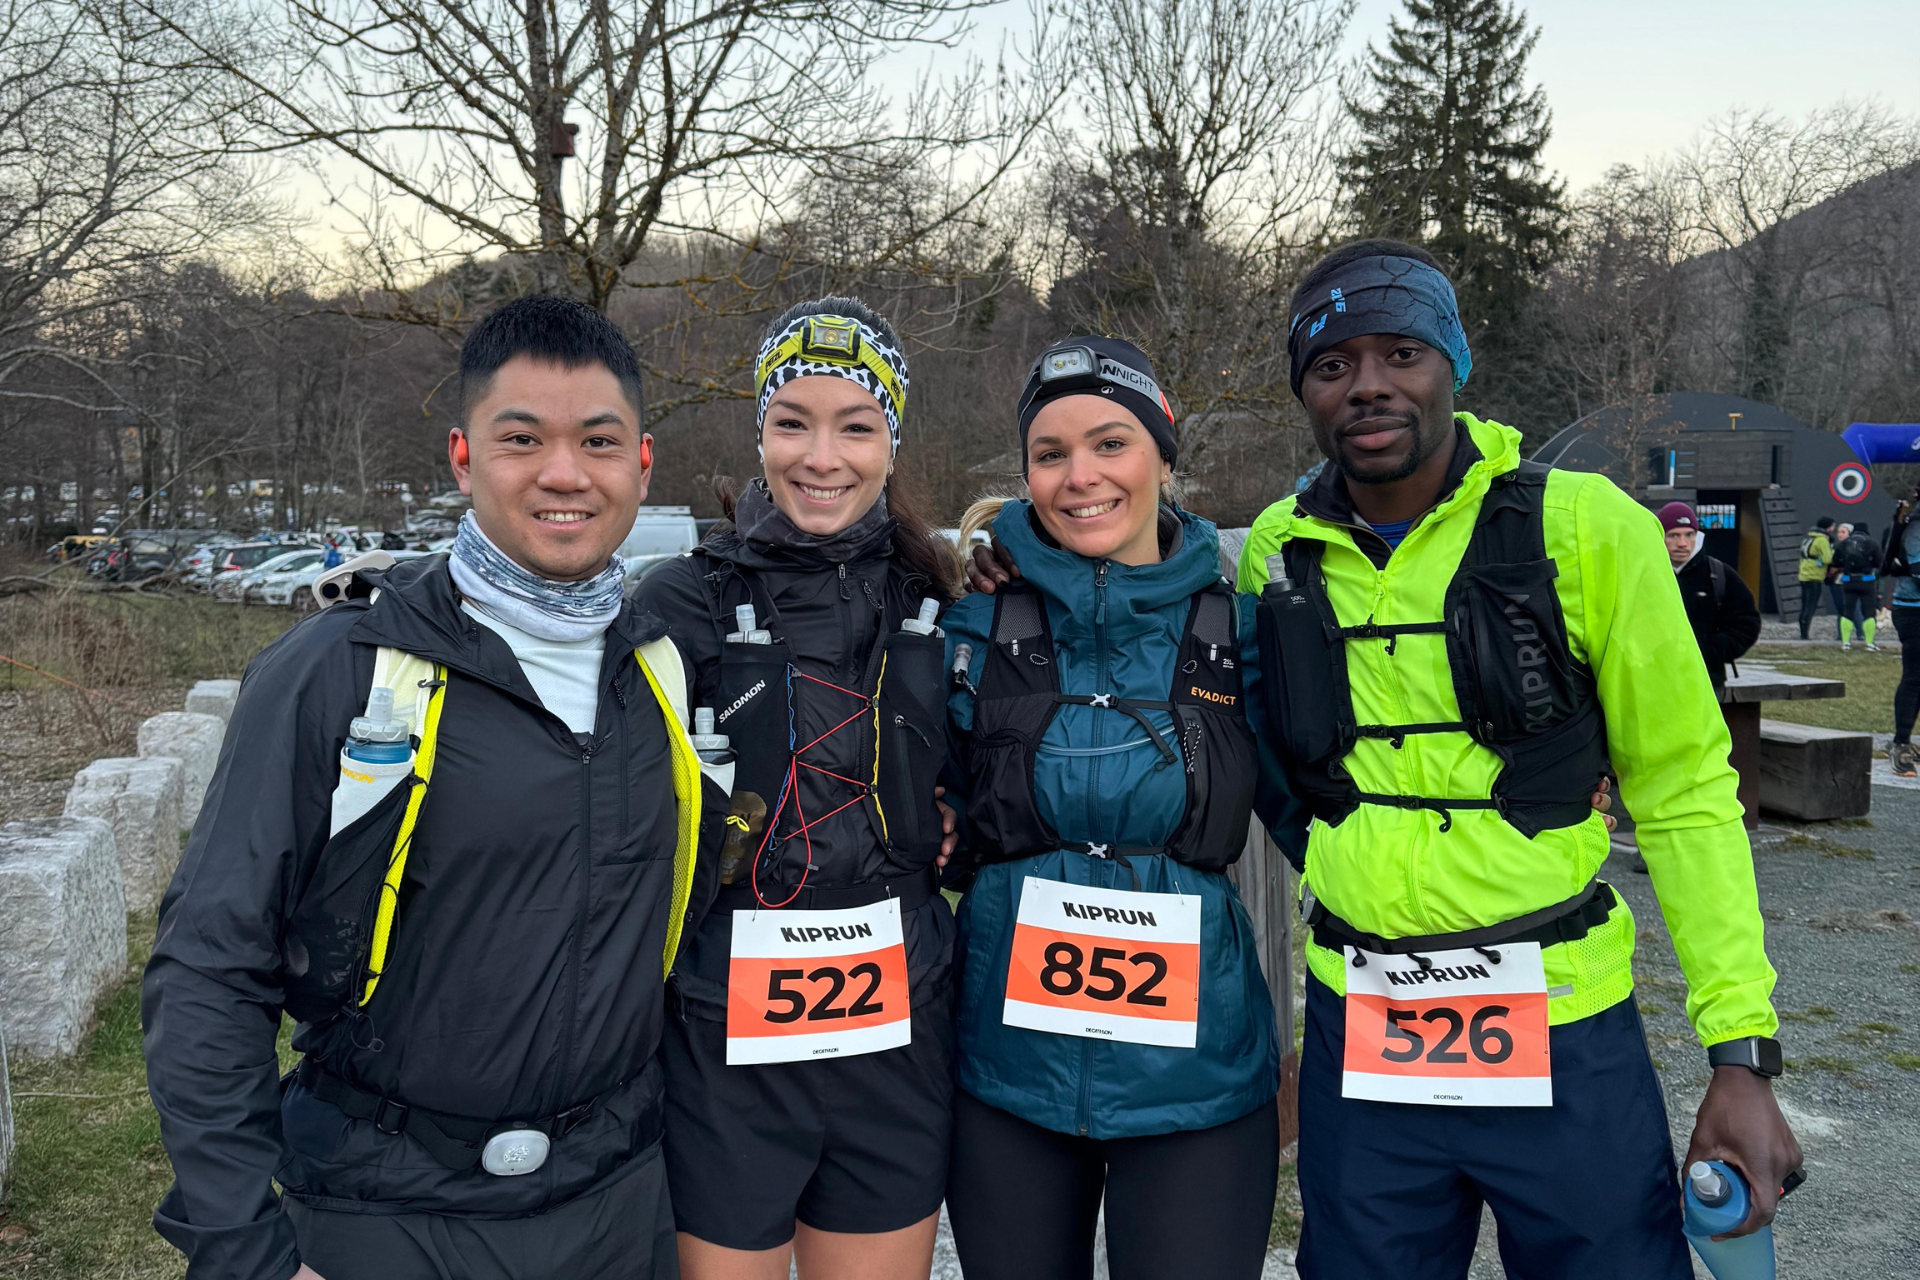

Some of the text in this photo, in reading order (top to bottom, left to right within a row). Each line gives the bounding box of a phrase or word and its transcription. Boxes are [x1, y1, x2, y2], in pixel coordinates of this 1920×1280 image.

[1100, 364, 1154, 393] NNIGHT
[718, 679, 766, 724] SALOMON
[1190, 686, 1237, 706] EVADICT
[1062, 901, 1158, 927] KIPRUN
[780, 922, 873, 943] KIPRUN
[1040, 941, 1168, 1007] 852
[1384, 964, 1491, 986] KIPRUN
[764, 962, 884, 1024] 522
[1380, 1004, 1514, 1065] 526
[1433, 1093, 1463, 1101] DECATHLON
